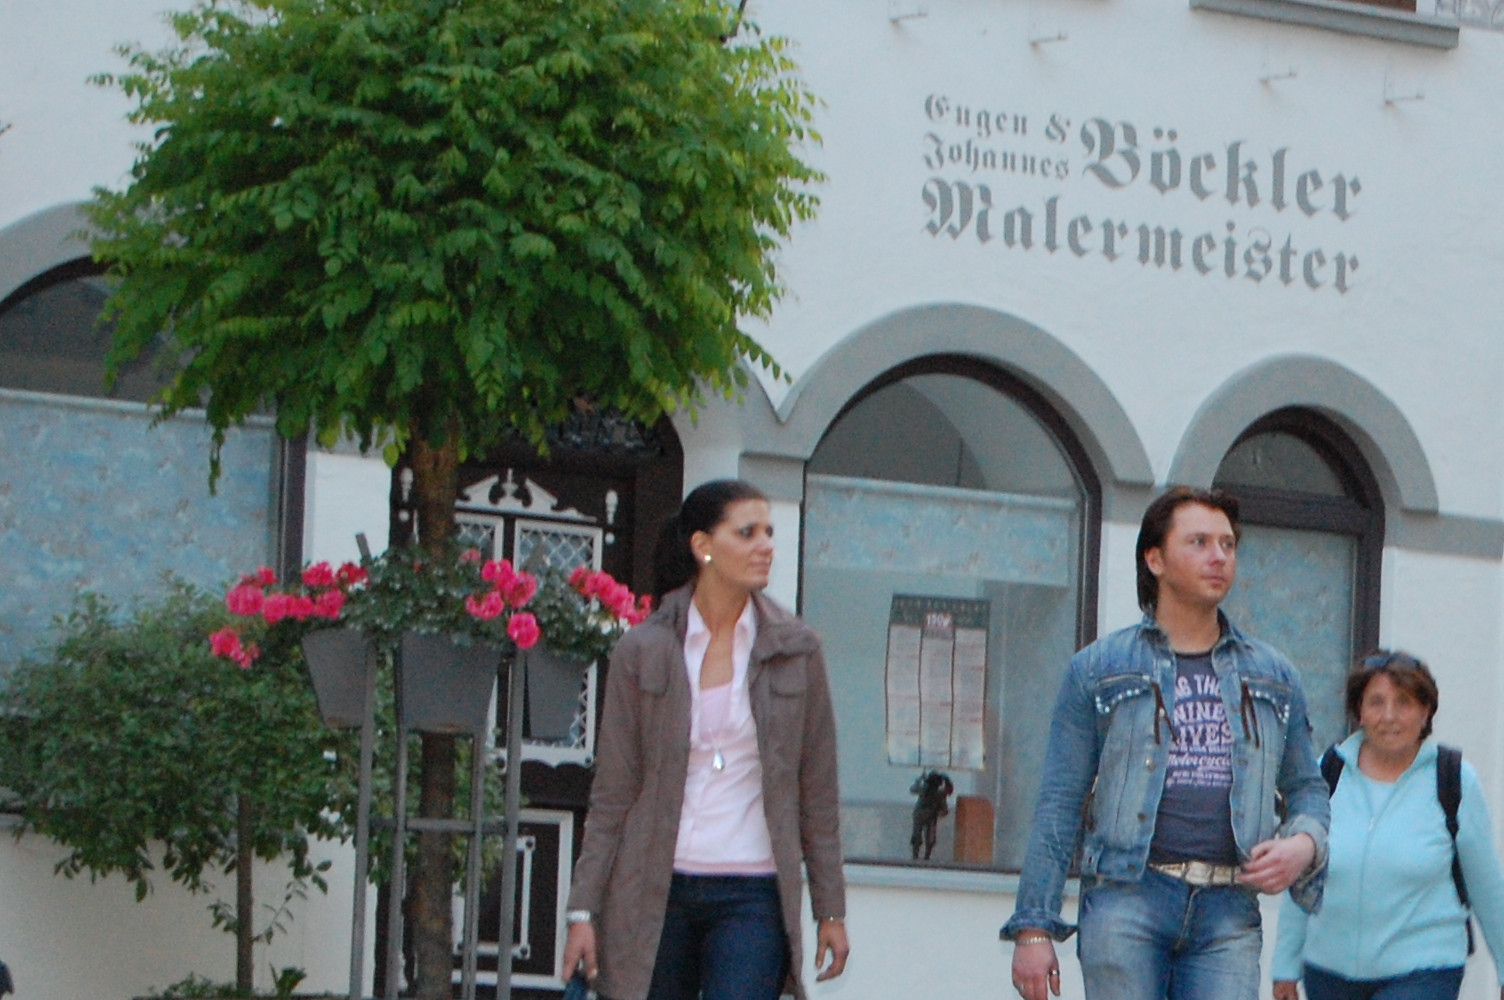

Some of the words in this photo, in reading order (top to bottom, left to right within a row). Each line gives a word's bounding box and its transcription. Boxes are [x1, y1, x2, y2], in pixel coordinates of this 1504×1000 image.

[922, 132, 1070, 181] Johannes
[923, 93, 1029, 138] Eugen
[1044, 112, 1071, 144] &
[1080, 116, 1362, 222] Böckler
[920, 176, 1361, 295] Malermeister
